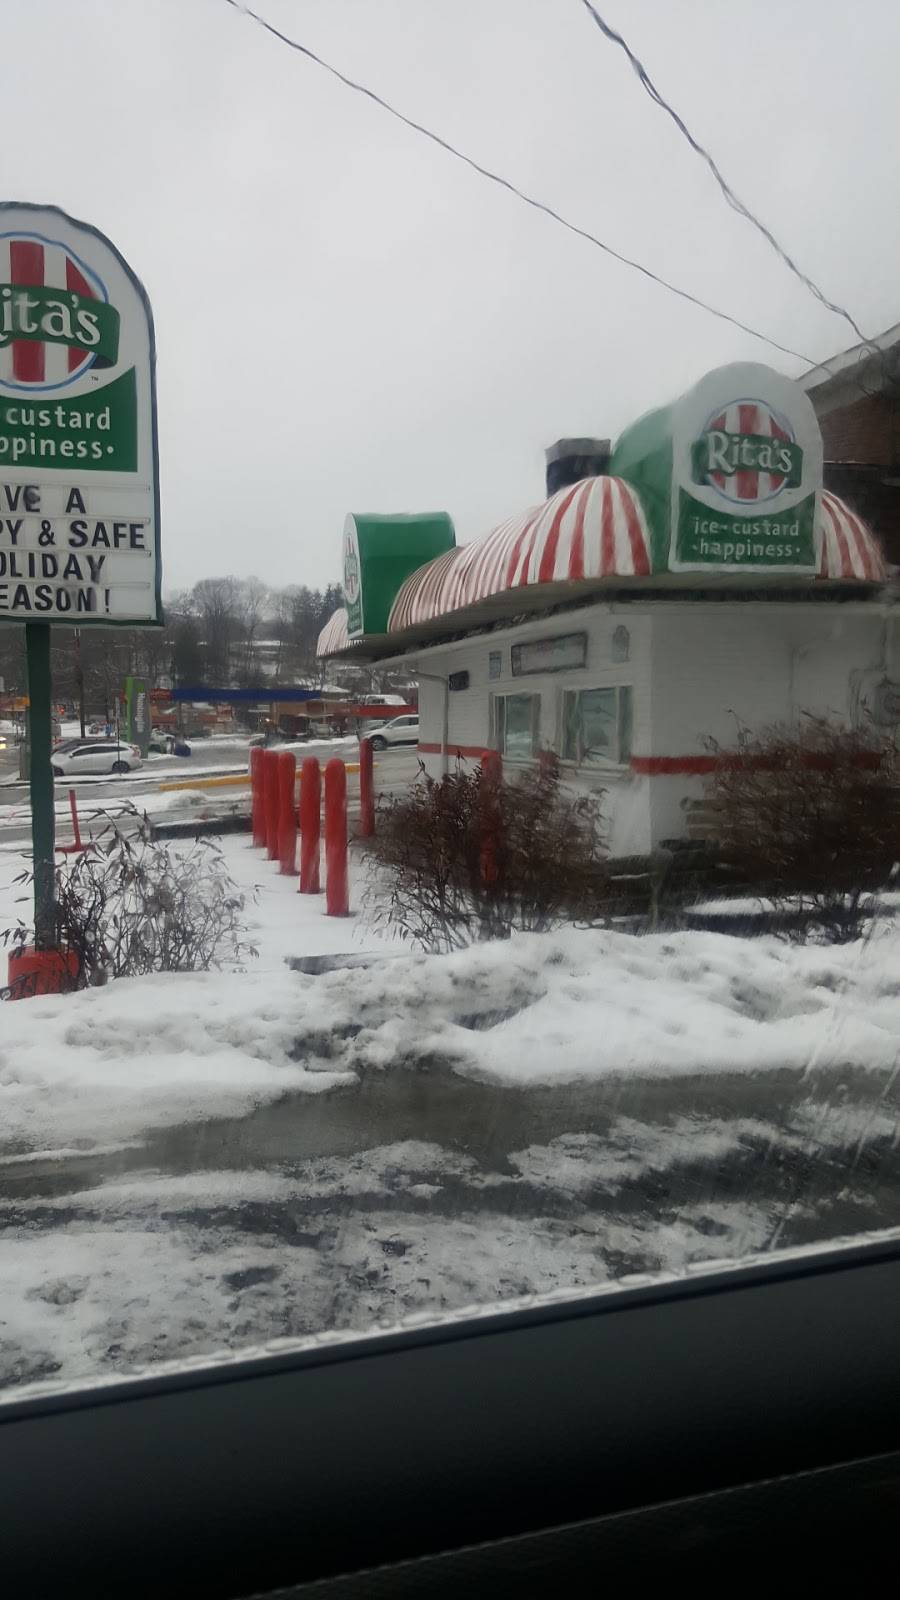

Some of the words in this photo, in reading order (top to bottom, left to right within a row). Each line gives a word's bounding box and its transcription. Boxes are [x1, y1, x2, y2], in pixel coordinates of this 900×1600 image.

[0, 288, 101, 346] ita's
[6, 406, 111, 430] custard
[707, 431, 793, 473] Rita's
[0, 485, 41, 513] VE
[65, 487, 87, 514] A
[0, 519, 24, 545] Y
[38, 519, 56, 547] &
[68, 520, 145, 549] SAFE
